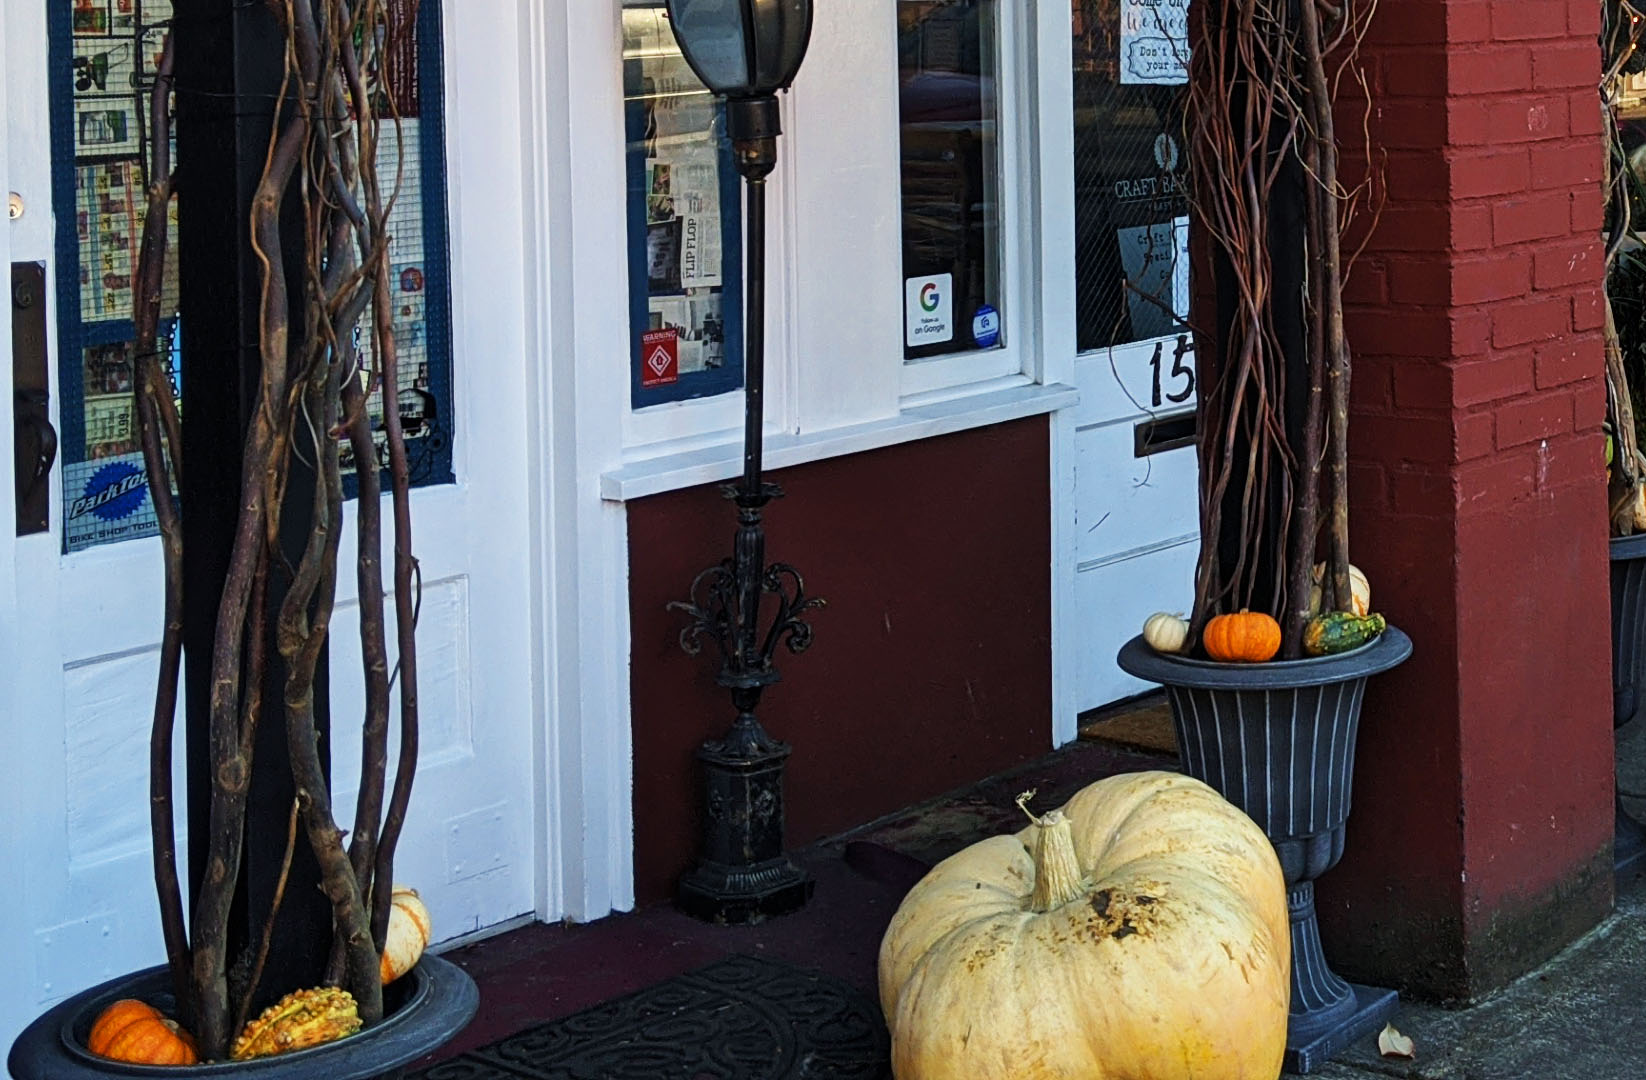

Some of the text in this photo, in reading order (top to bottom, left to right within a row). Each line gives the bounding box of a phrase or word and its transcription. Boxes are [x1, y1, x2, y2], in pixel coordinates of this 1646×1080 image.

[1139, 46, 1167, 58] Don't
[1146, 60, 1169, 73] your
[1114, 177, 1158, 199] CRAFT
[685, 218, 697, 279] FLIP FLOP
[923, 323, 946, 334] Google
[642, 330, 677, 342] WARNING
[70, 534, 94, 544] BIKE
[98, 526, 128, 538] SHOP
